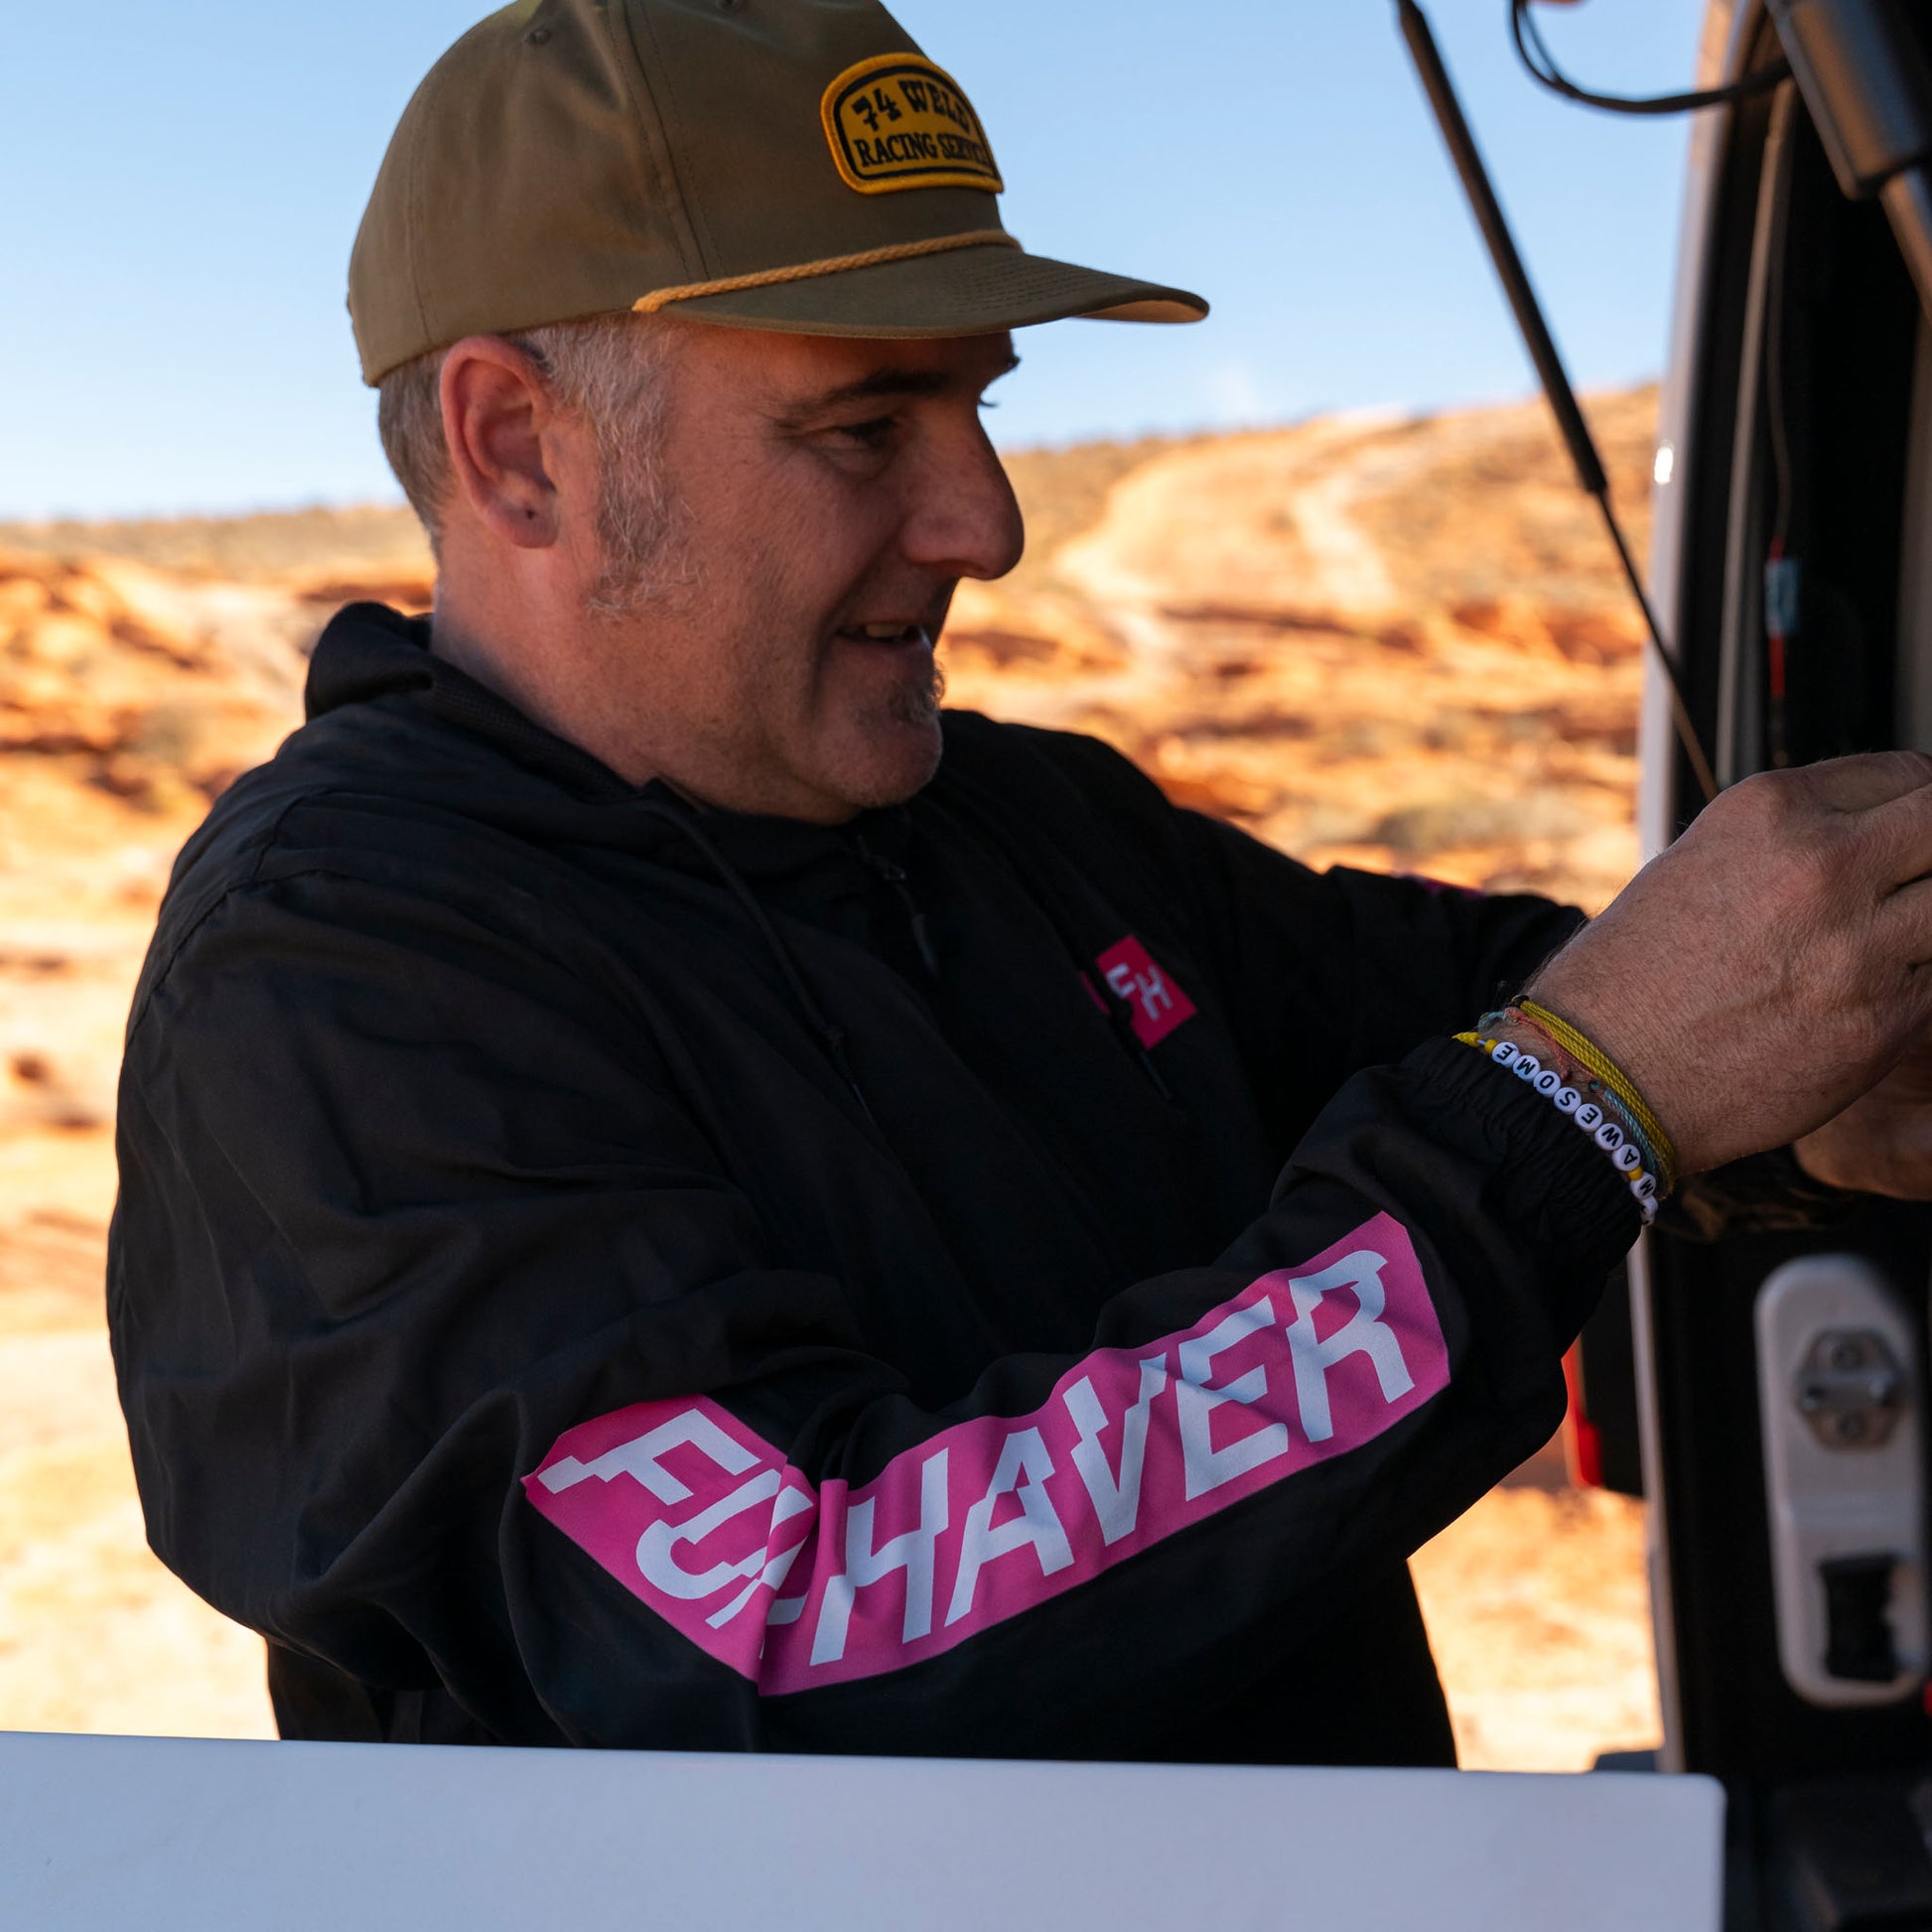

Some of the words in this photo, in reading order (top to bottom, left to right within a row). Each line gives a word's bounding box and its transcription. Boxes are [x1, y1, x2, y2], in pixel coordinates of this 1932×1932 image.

[851, 87, 902, 132] 74
[853, 131, 939, 168] RACING
[1495, 1043, 1639, 1166] AWESOME
